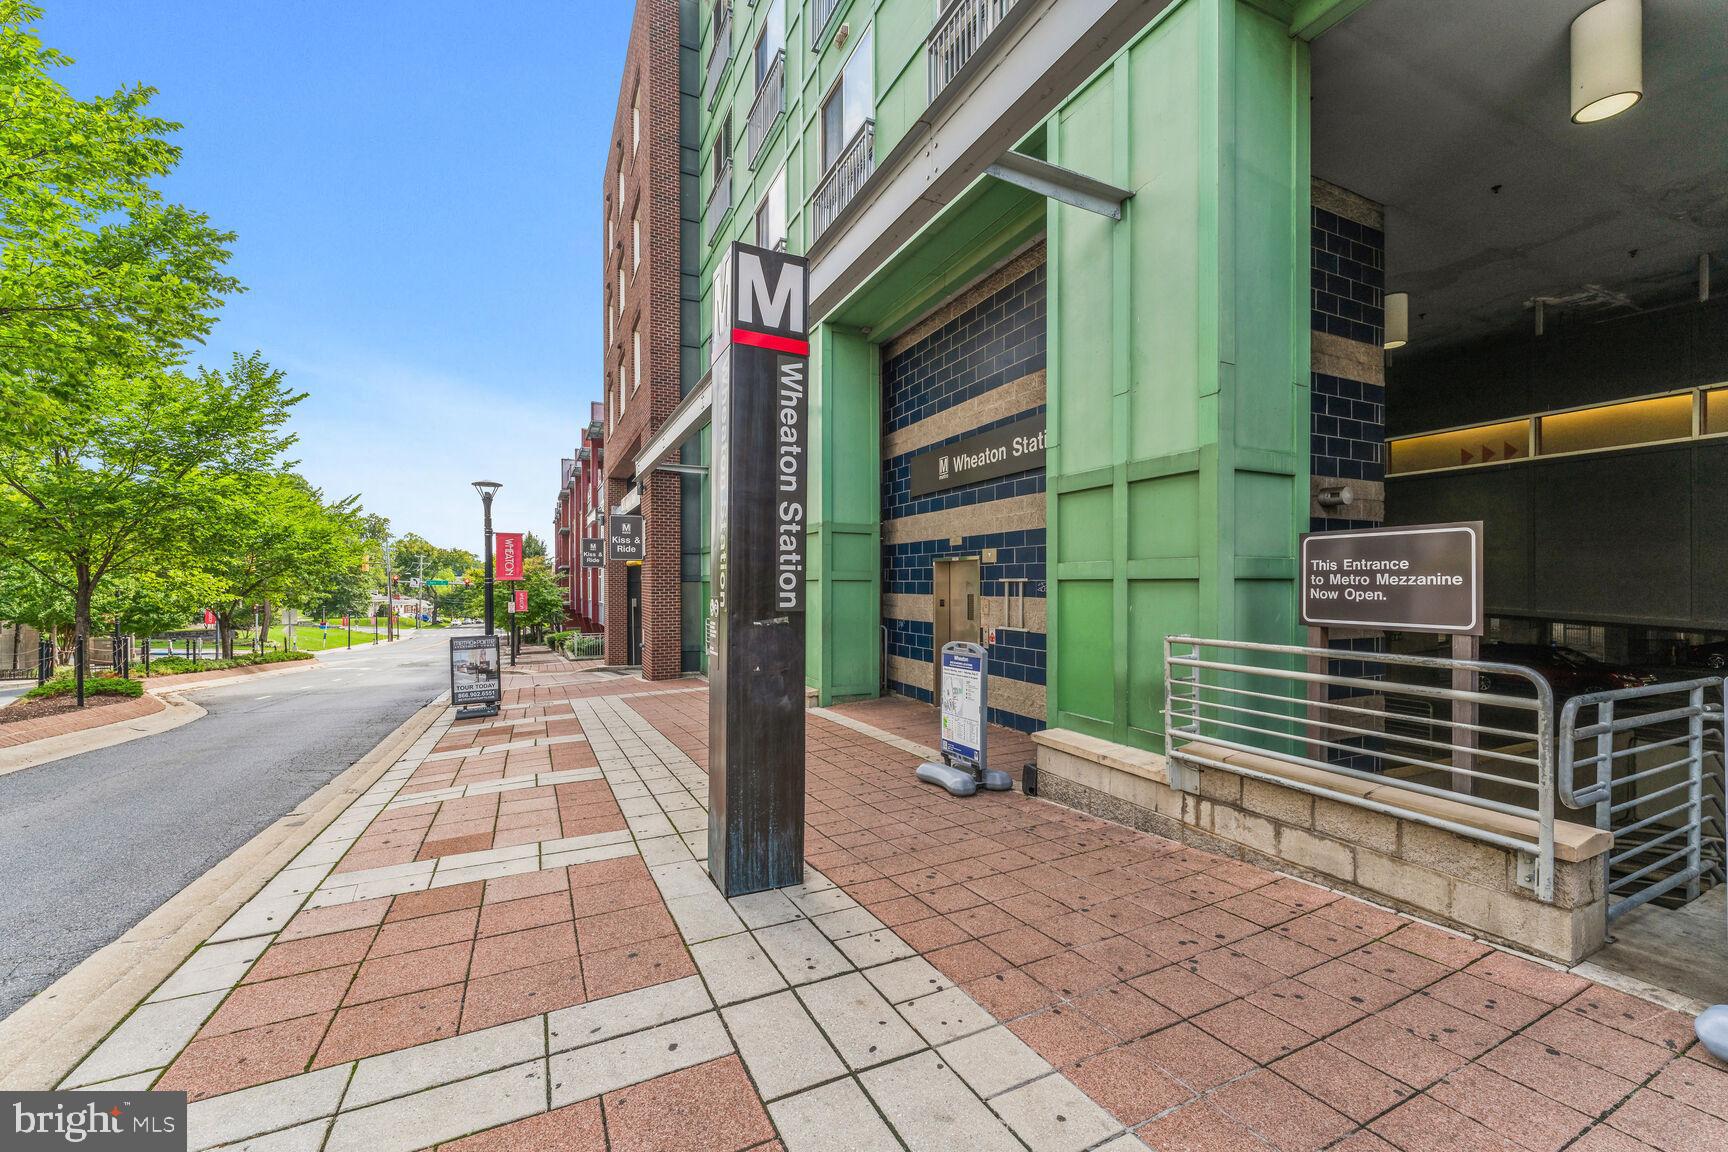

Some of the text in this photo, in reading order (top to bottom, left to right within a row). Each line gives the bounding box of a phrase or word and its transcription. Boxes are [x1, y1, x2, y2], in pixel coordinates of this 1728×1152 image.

[738, 251, 804, 333] M
[953, 446, 1006, 473] Wheaton
[779, 363, 803, 608] Wheaton Station
[504, 538, 514, 576] WHEATON
[617, 545, 636, 553] Ride
[1310, 559, 1410, 571] This Entrance
[1311, 573, 1463, 585] to Metro Mezzanine
[1310, 588, 1387, 602] Now Open.
